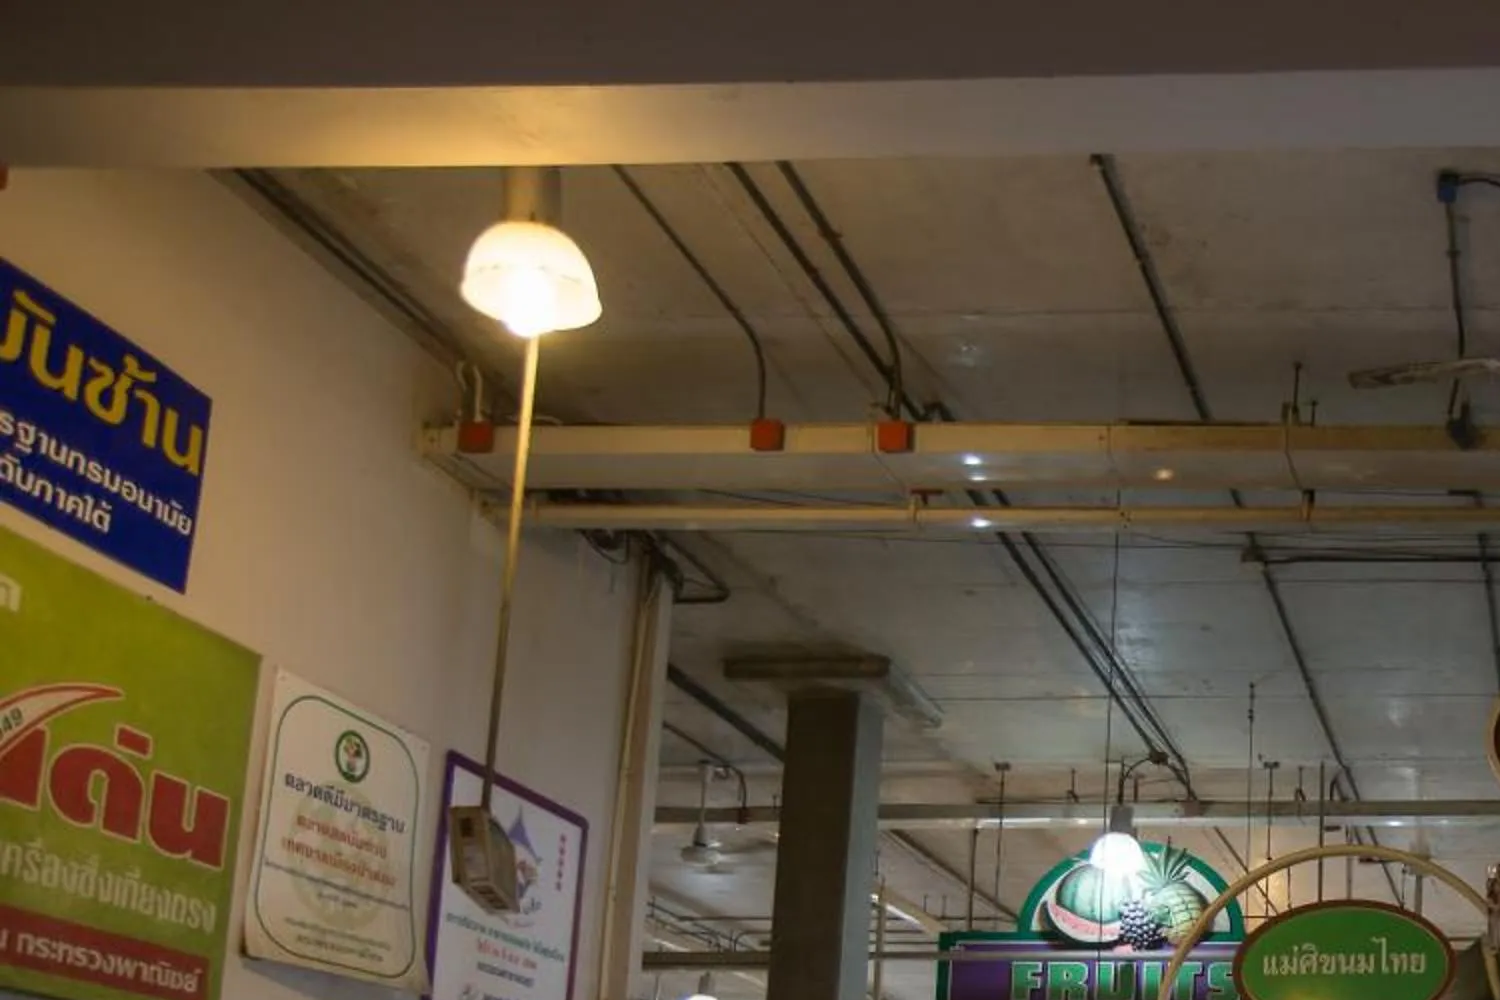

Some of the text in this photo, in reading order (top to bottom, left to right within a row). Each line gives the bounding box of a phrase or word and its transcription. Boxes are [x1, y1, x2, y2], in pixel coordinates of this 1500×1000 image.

[16, 932, 204, 993] กระทรวงพาณิชย์
